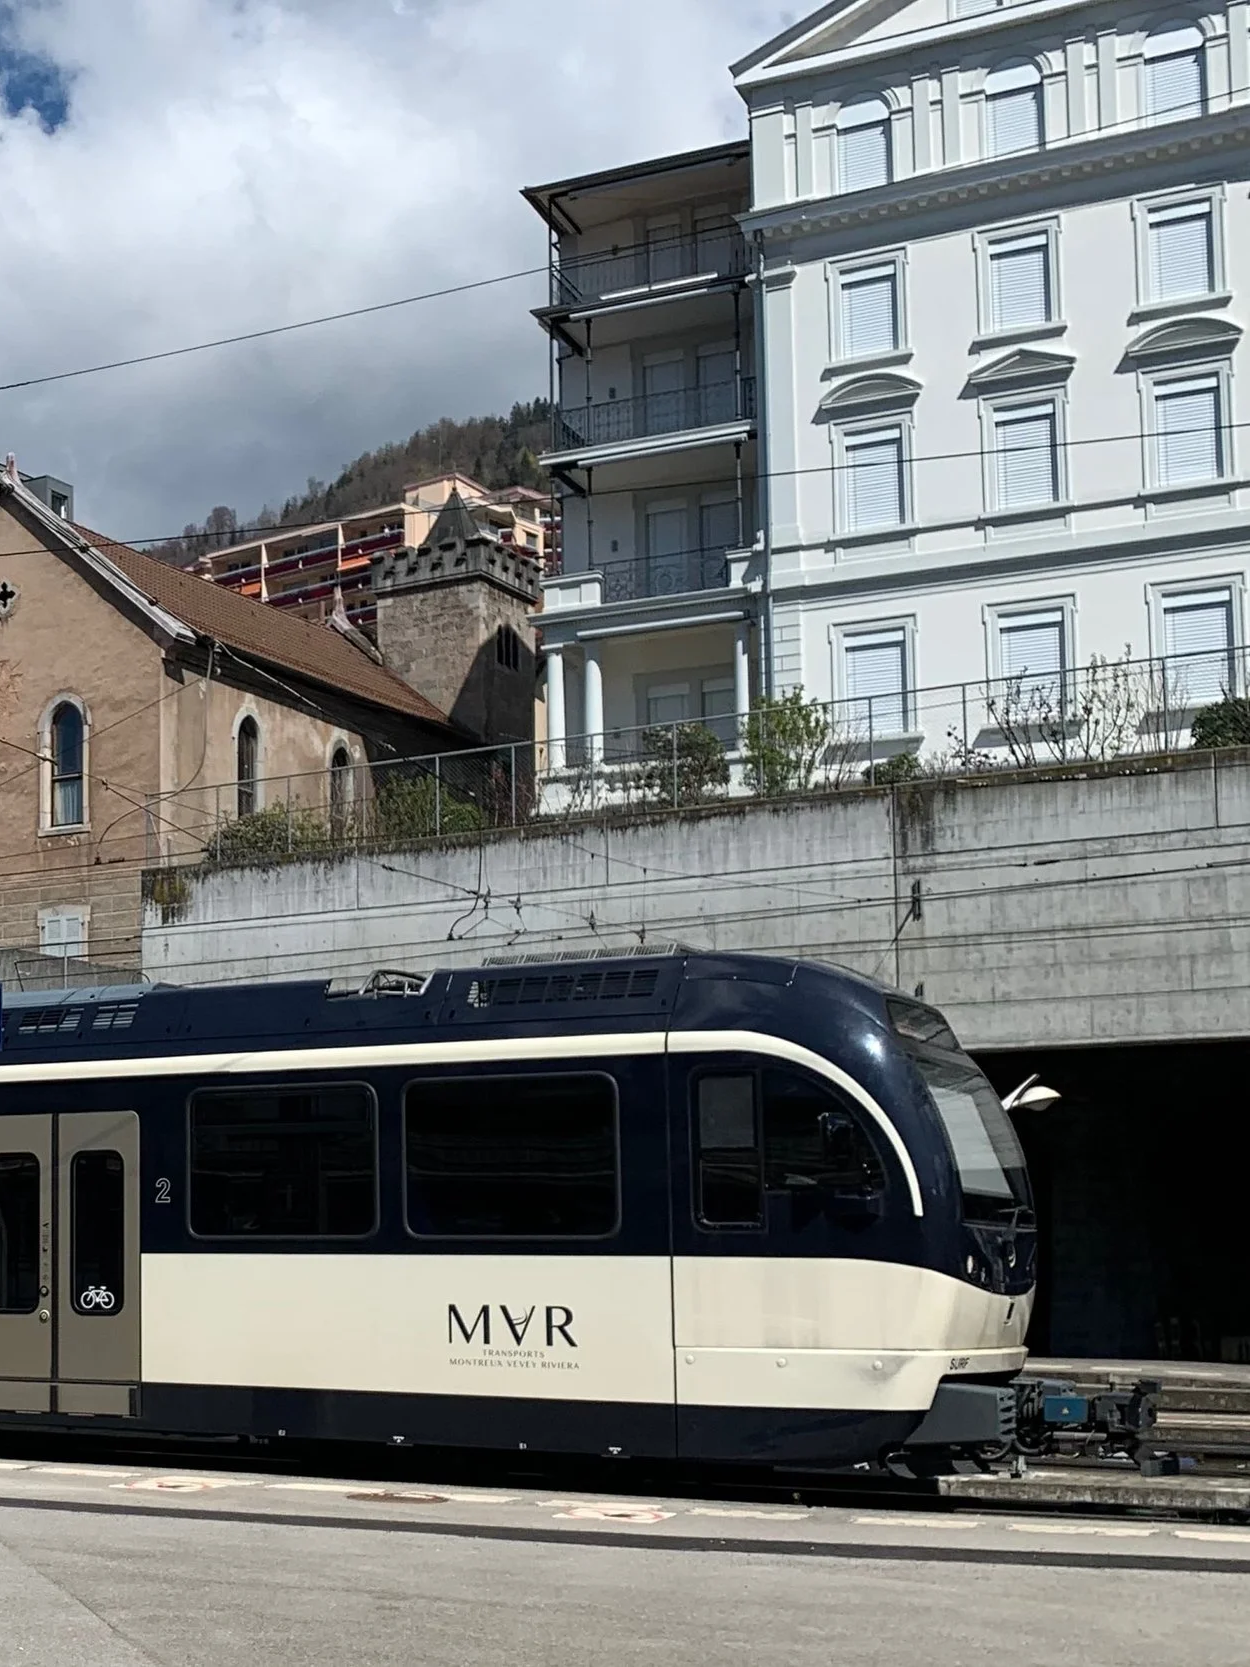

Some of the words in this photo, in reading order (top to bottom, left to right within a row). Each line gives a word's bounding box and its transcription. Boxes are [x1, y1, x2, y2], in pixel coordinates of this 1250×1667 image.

[154, 1177, 171, 1203] 2
[482, 1348, 545, 1358] TRANSPORTS
[449, 1358, 504, 1368] MONTREUX
[506, 1359, 537, 1369] VEVEY
[541, 1360, 580, 1370] RIVIERA
[949, 1357, 970, 1370] SURF
